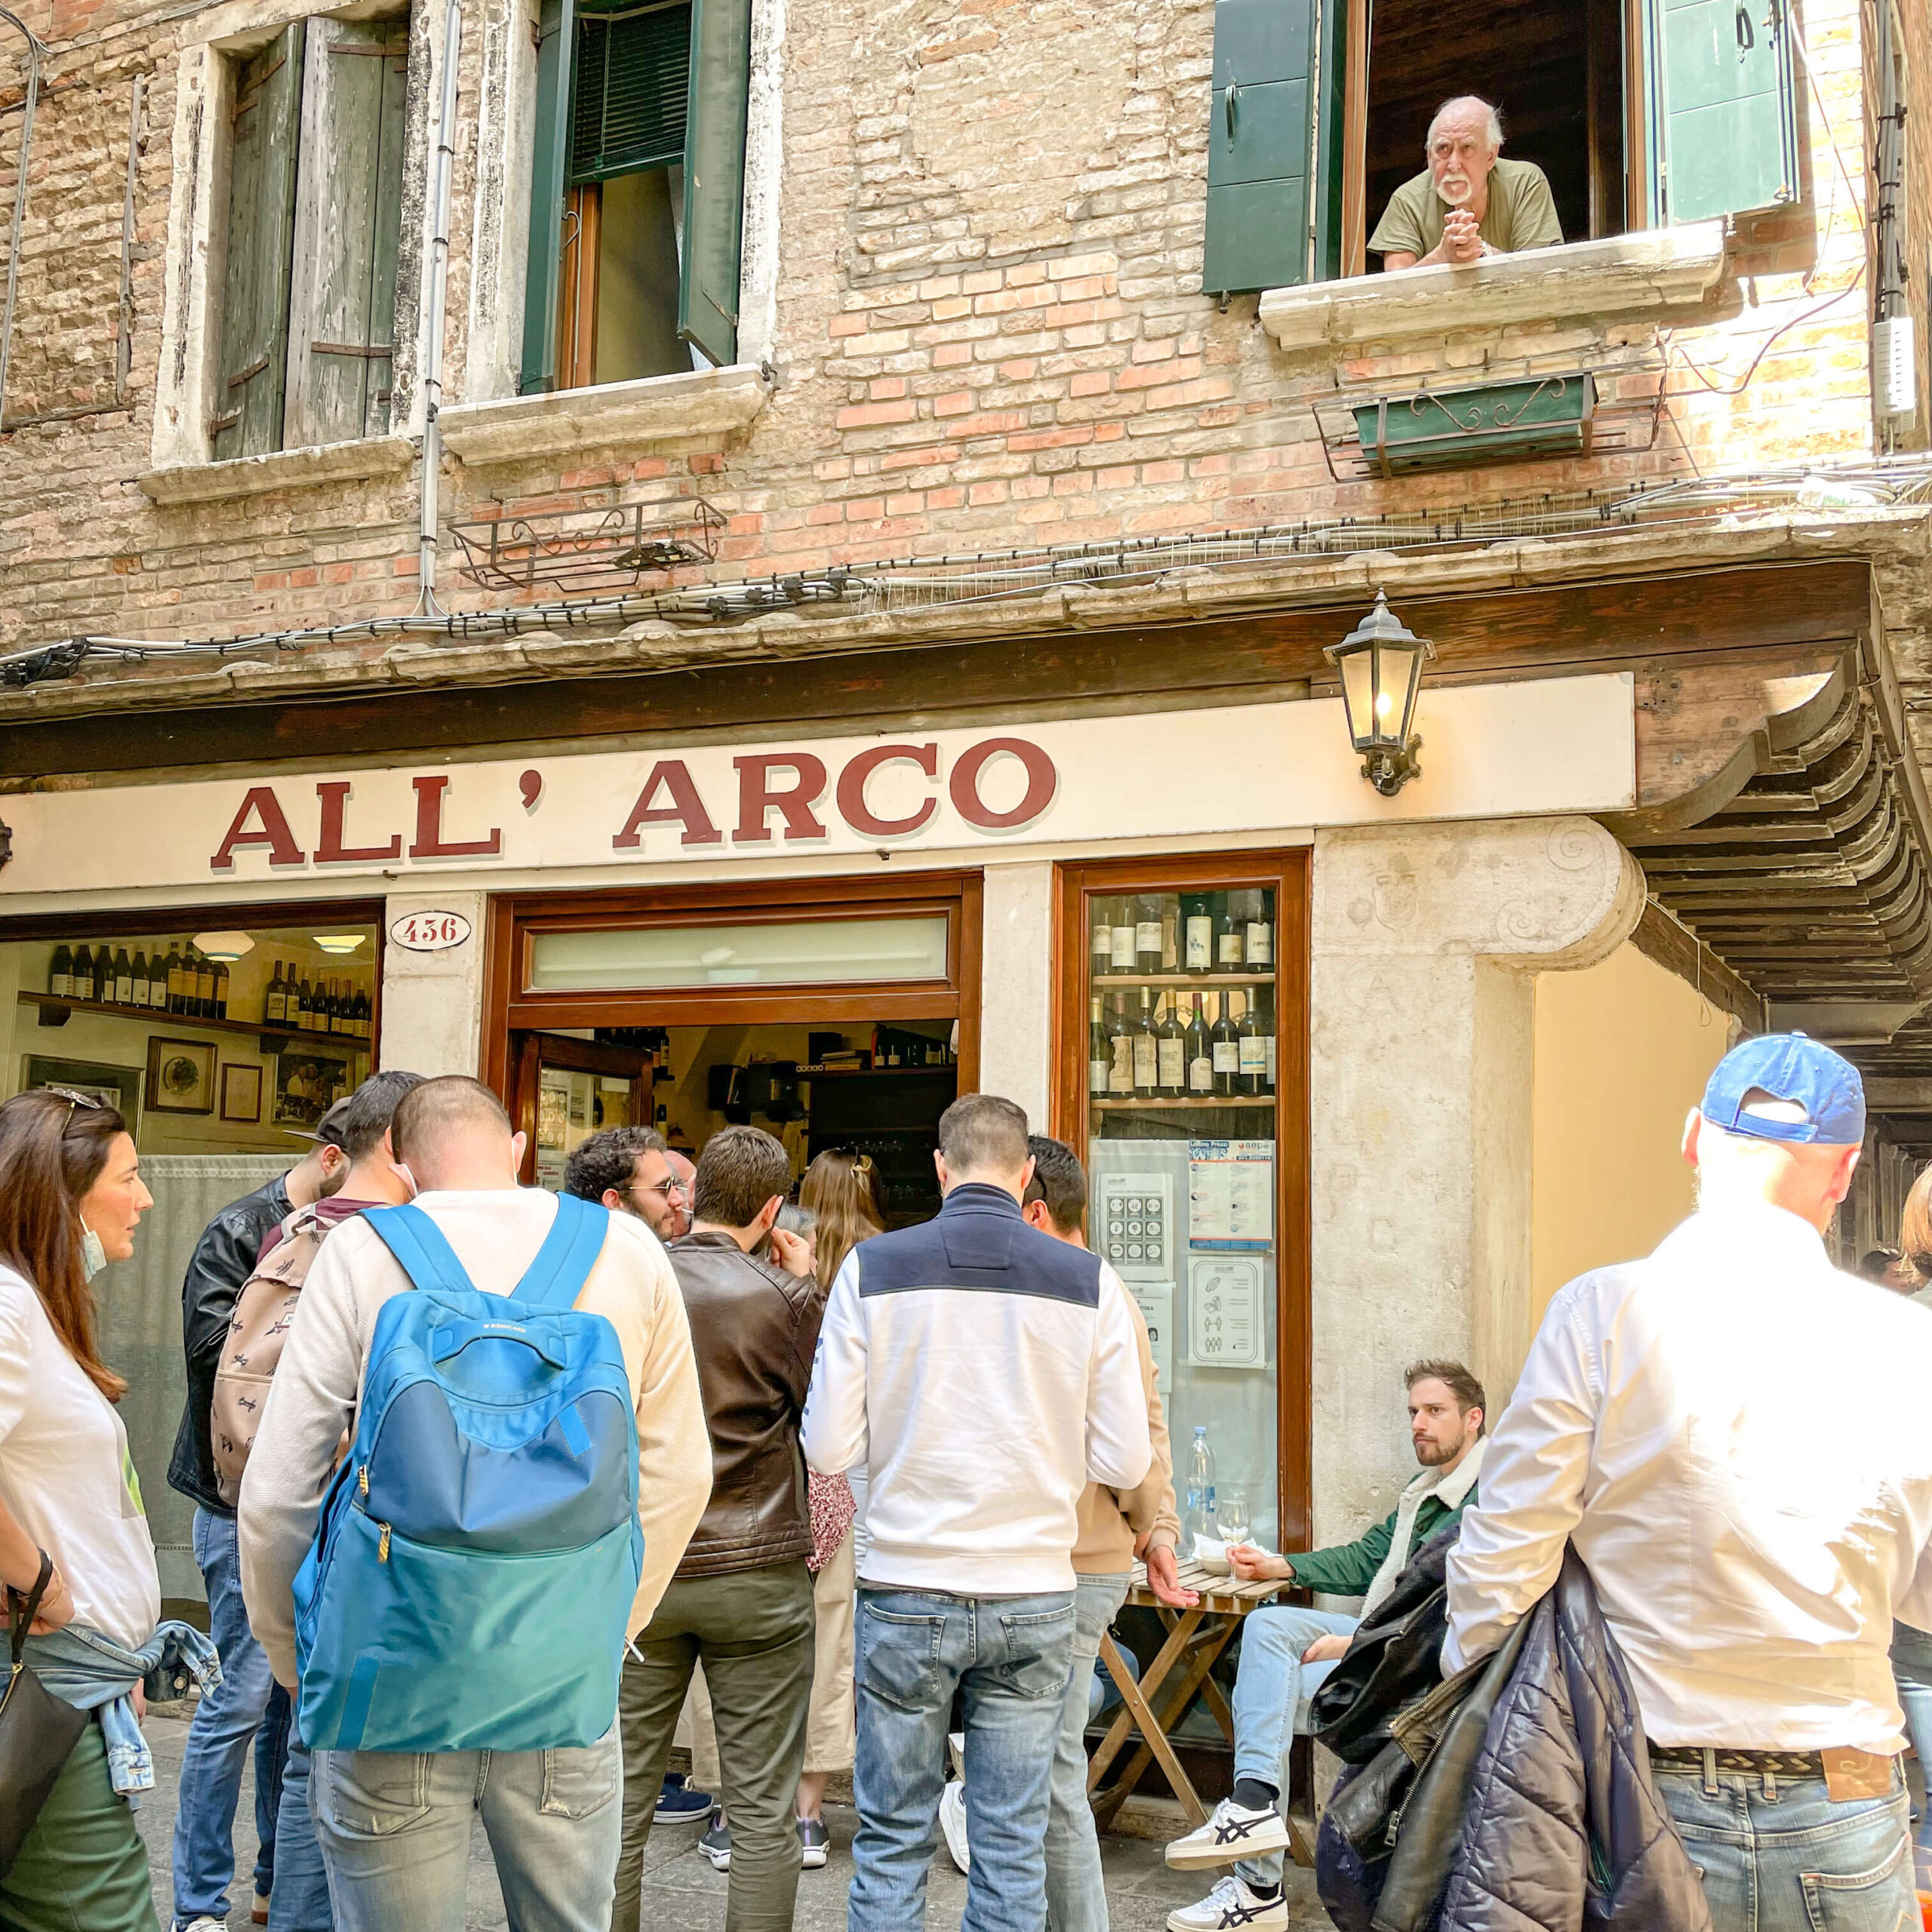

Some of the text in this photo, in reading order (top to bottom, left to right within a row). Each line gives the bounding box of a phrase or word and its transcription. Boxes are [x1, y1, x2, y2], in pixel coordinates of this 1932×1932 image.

[211, 737, 1058, 868] ALL' ARCO
[402, 918, 457, 942] 436
